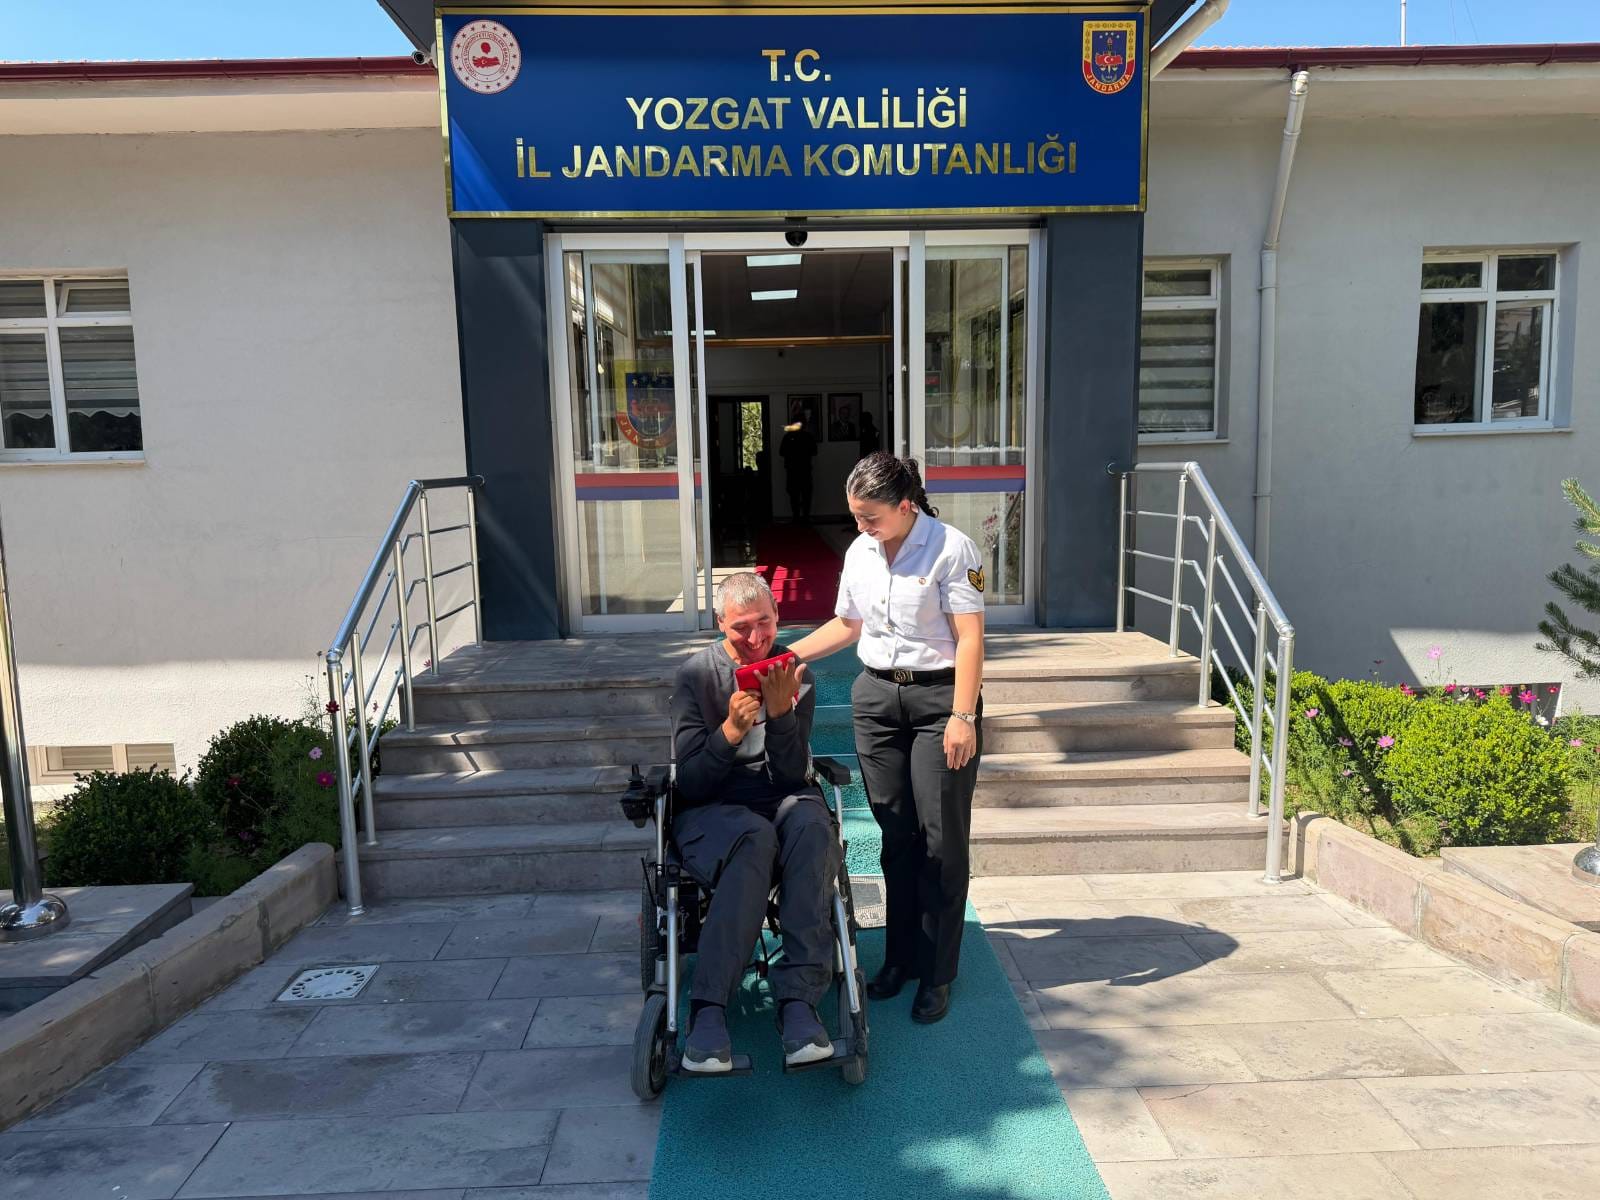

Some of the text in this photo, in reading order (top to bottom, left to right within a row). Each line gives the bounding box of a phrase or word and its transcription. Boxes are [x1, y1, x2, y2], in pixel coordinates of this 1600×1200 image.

[761, 48, 832, 83] T.C.
[1086, 73, 1131, 92] JANDARMA
[625, 86, 967, 131] YOZGAT VALİLİĞİ
[515, 134, 1077, 178] İL JANDARMA KOMUTANLIĞI
